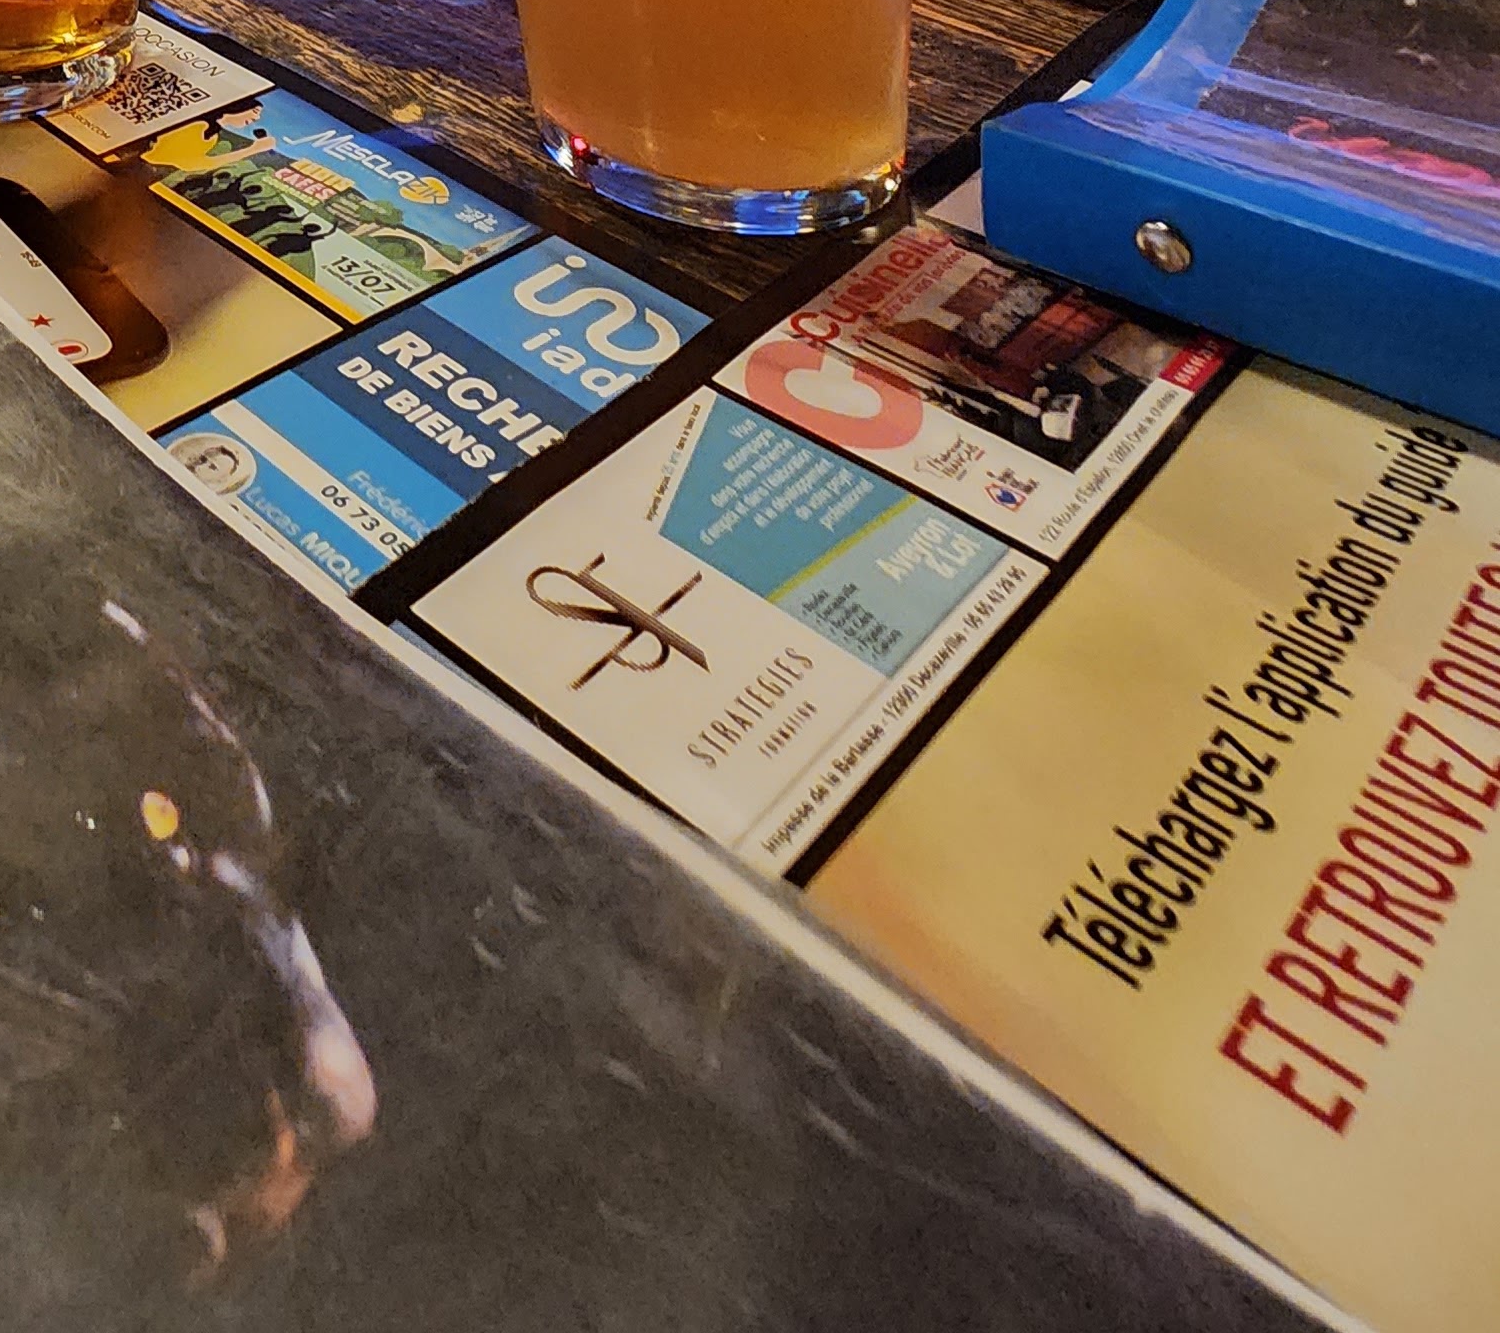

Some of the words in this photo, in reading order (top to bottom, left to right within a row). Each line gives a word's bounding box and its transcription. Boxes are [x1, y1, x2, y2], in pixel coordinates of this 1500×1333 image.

[329, 255, 397, 296] 13/07
[377, 329, 567, 458] RECHE
[522, 327, 636, 399] iad
[337, 356, 395, 396] DE
[383, 388, 498, 470] BIENS
[243, 485, 299, 537] Lucas
[320, 484, 350, 508] 06
[349, 506, 381, 531] 73
[1374, 425, 1469, 514] guide
[875, 516, 951, 584] Aveyron
[936, 531, 981, 565] Lot
[1333, 491, 1425, 546] du
[1203, 535, 1401, 745] l'application
[684, 646, 815, 769] STRATEGIES
[1046, 726, 1280, 992] Téléchargez
[1262, 709, 1500, 1048] RETROUVEZ
[1218, 991, 1368, 1136] ET
